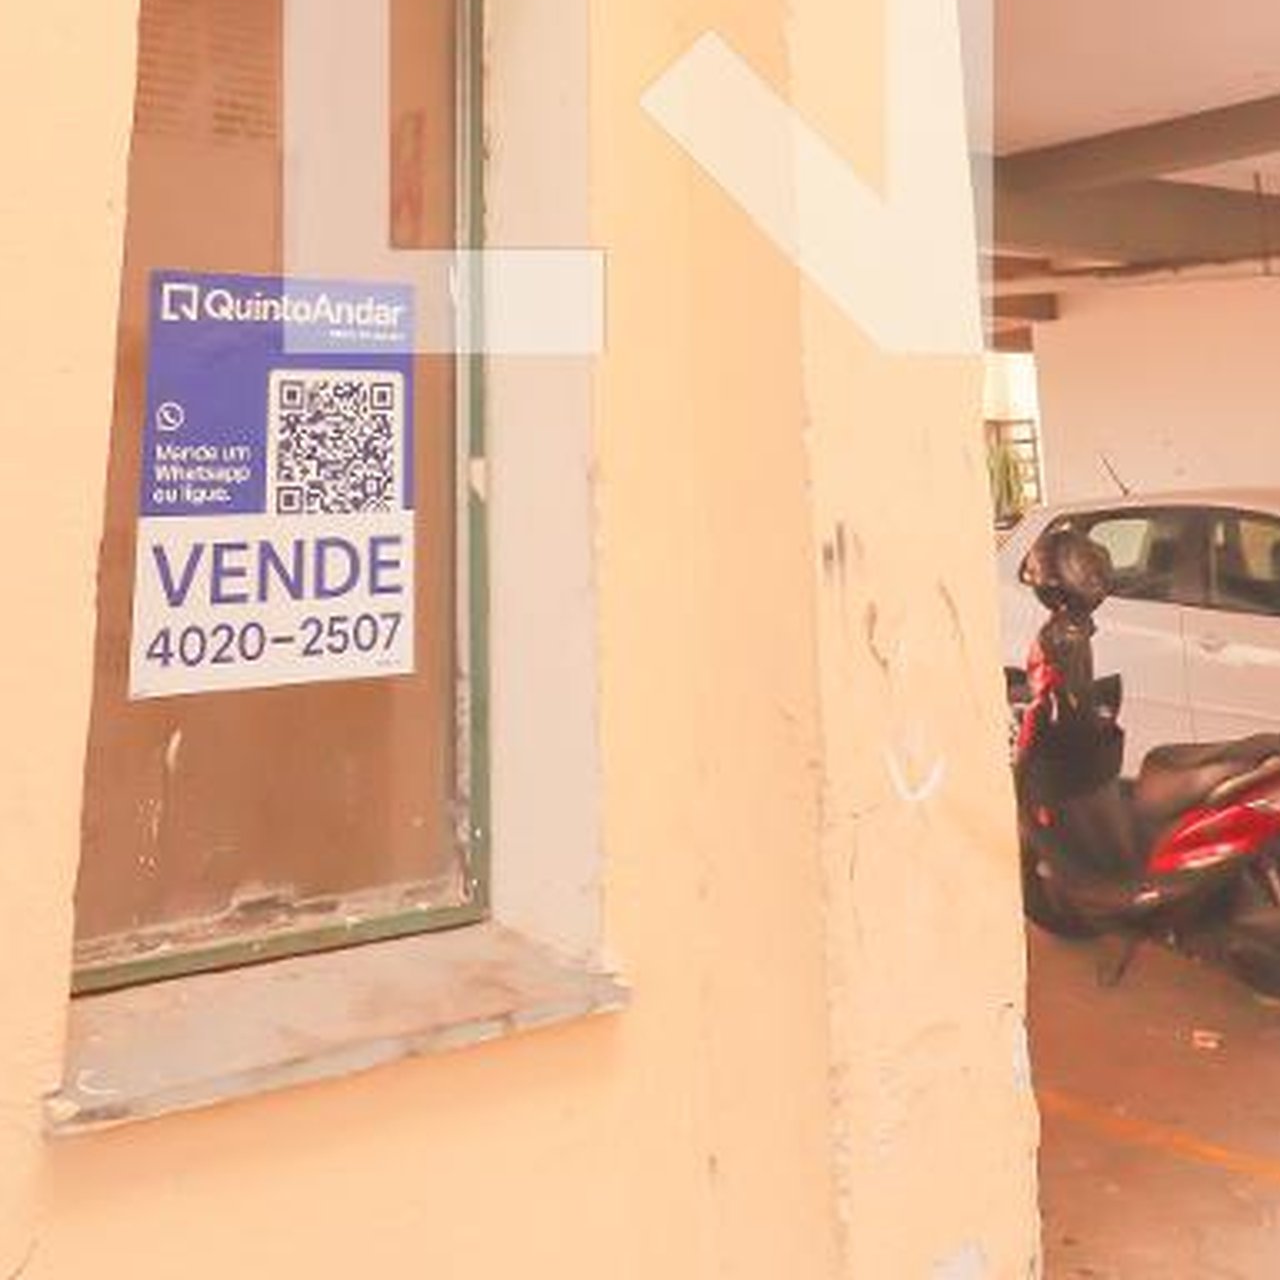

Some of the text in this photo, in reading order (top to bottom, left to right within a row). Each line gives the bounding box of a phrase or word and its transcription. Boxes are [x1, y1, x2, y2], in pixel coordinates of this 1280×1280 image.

[204, 288, 402, 326] QuintoAndar
[223, 446, 251, 462] um
[153, 488, 177, 503] ou
[152, 535, 404, 608] VENDE
[146, 611, 403, 668] 4020-2507
